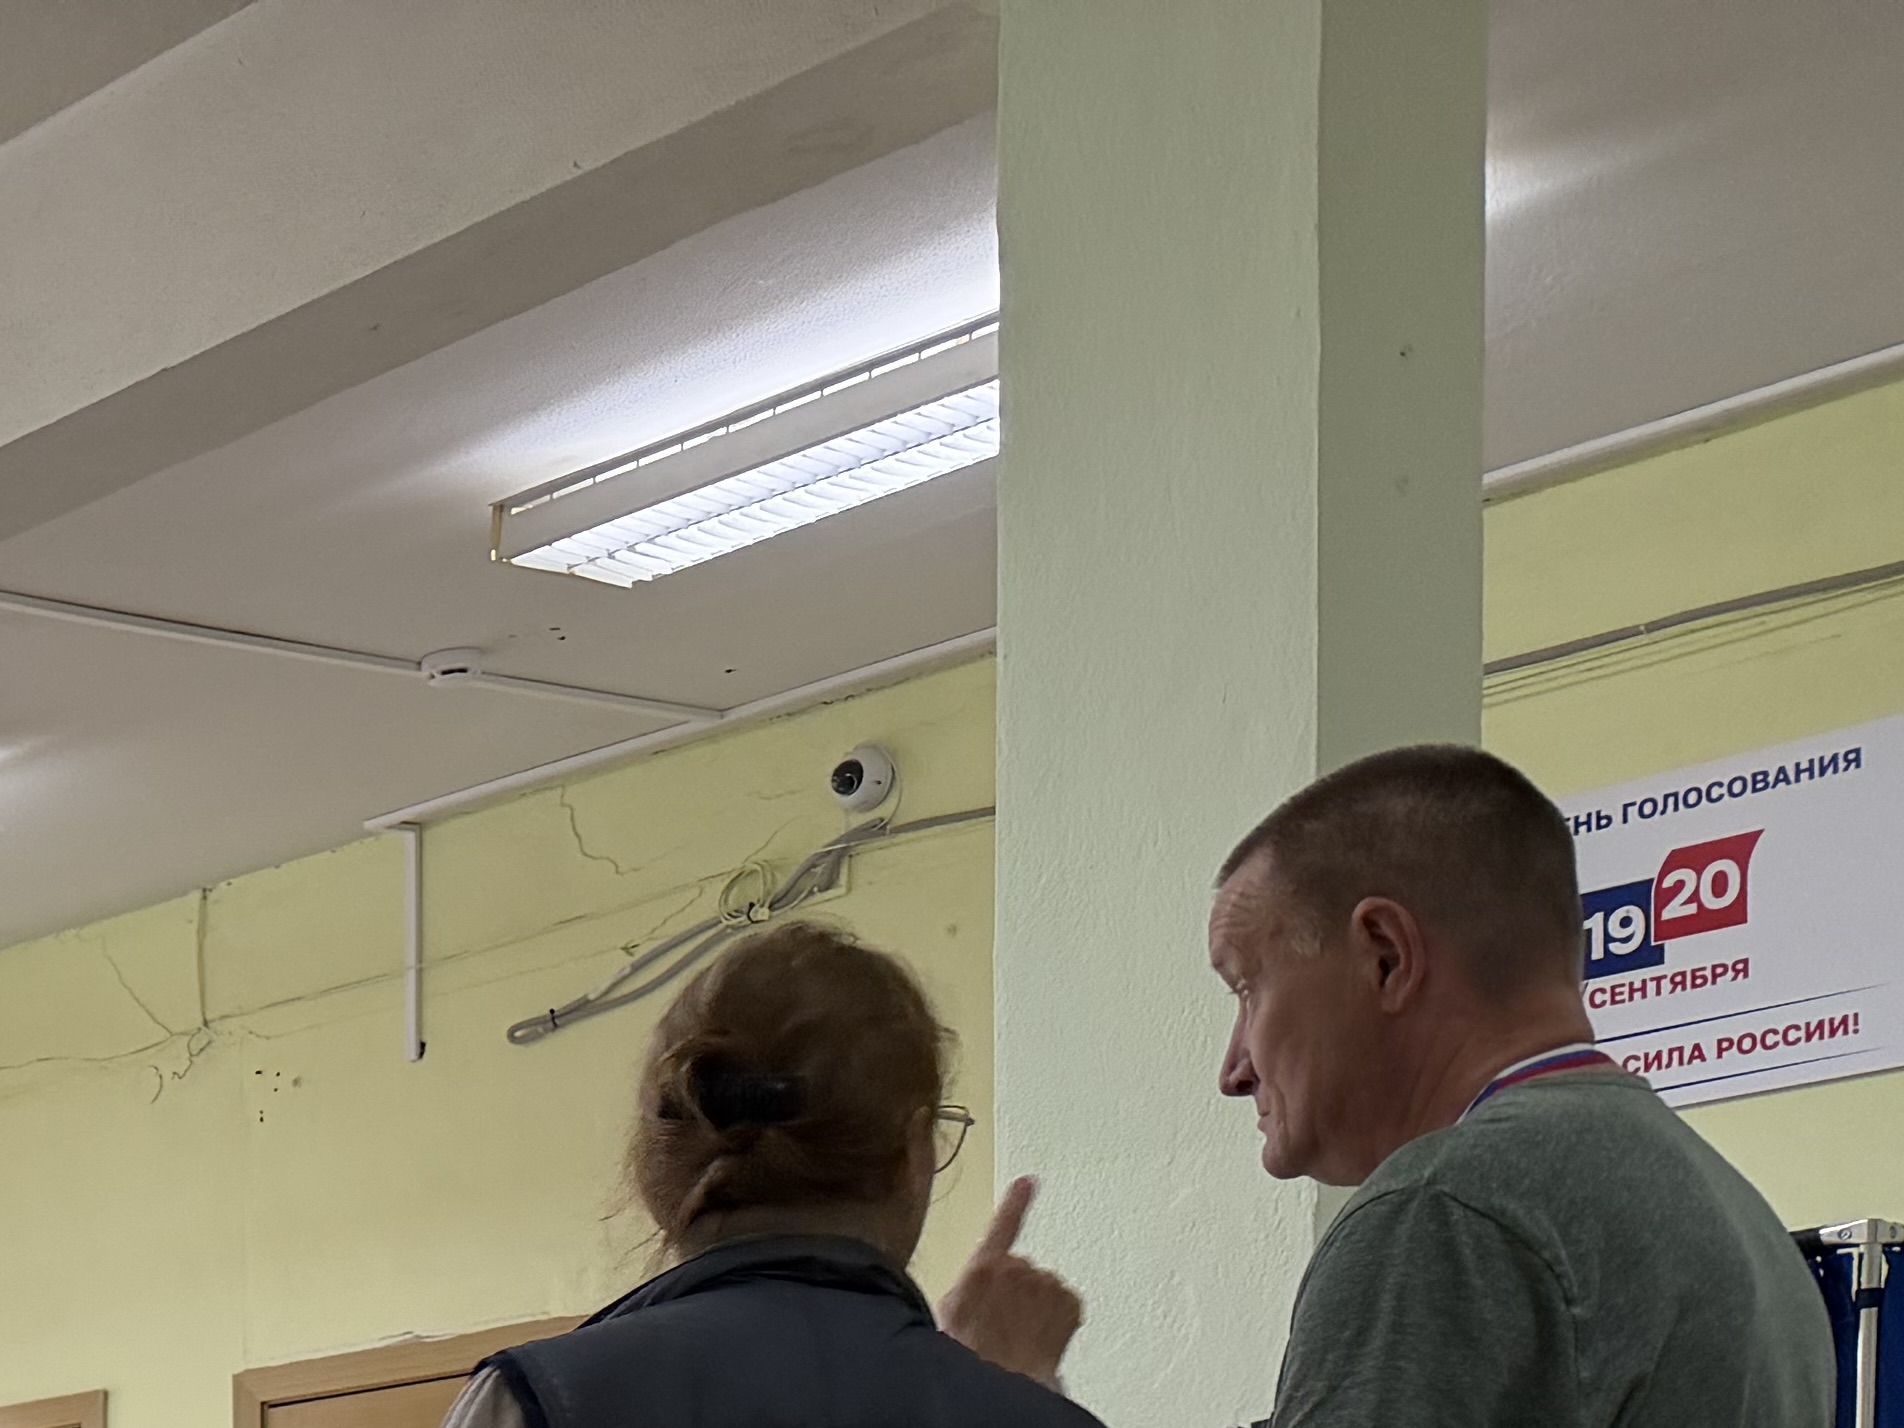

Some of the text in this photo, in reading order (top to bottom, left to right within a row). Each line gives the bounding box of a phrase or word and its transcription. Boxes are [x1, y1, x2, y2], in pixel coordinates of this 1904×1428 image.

[1564, 746, 1863, 836] НЬ ГОЛОСОВАНИЯ
[1660, 857, 1741, 922] 20
[1582, 903, 1647, 962] 19
[1588, 957, 1751, 1010] СЕНТЯБРЯ
[1621, 1012, 1862, 1077] СИЛА РОССИИ!
